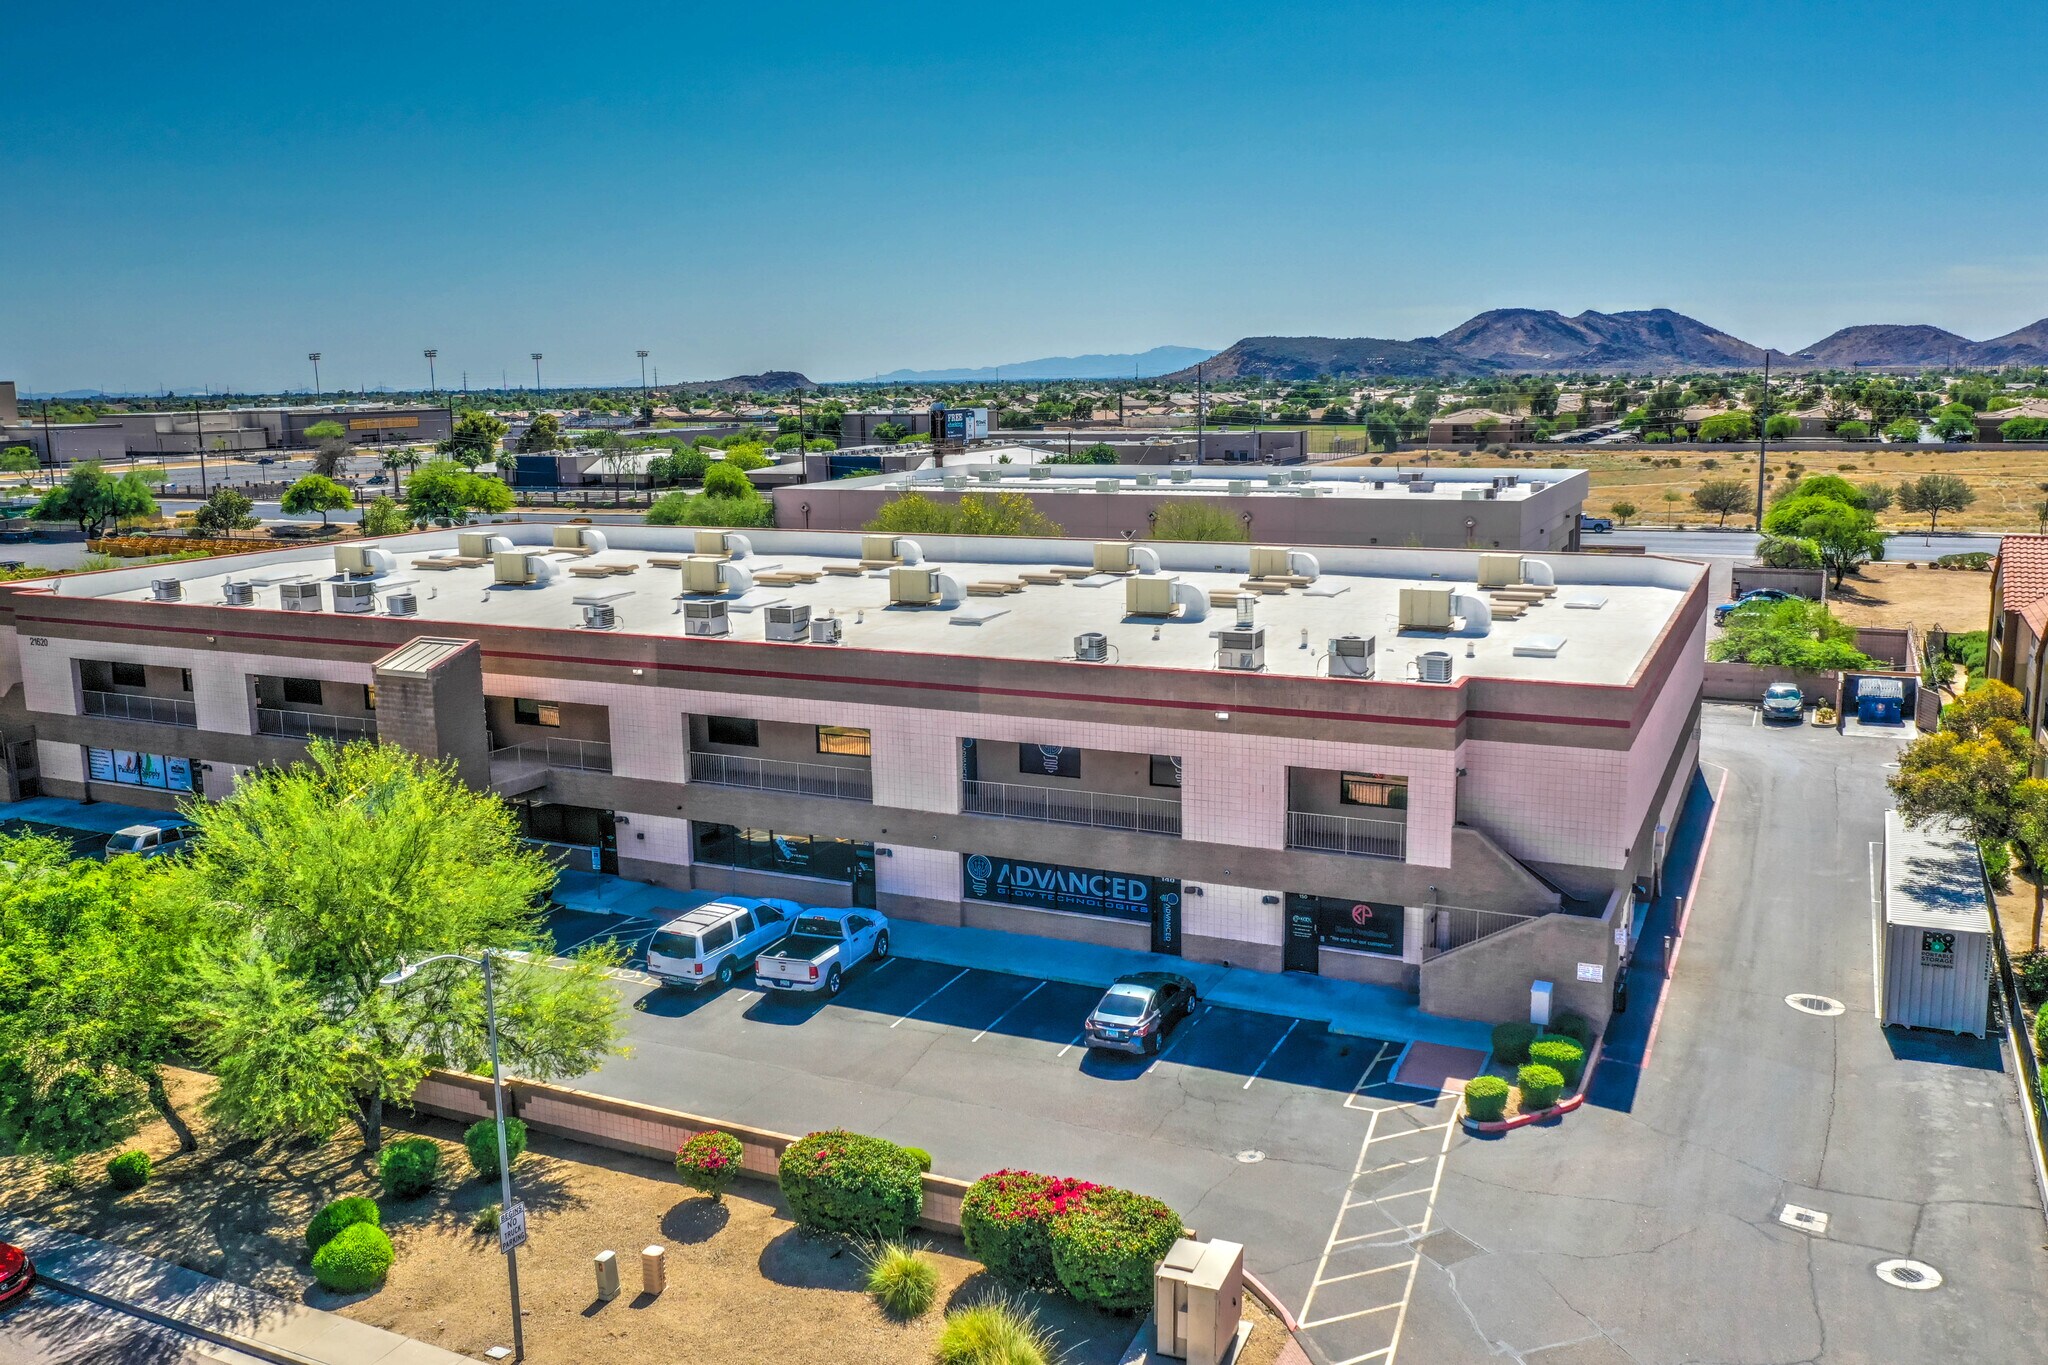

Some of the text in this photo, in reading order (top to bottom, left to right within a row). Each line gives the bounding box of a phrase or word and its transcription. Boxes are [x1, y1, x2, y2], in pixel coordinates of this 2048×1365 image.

[947, 413, 963, 422] FREE
[30, 637, 48, 646] 21620
[997, 864, 1147, 901] ADVANCED
[997, 888, 1149, 913] GLOW TECHNOLOGIES
[1920, 956, 1954, 964] STORAGE
[500, 1205, 523, 1222] BEGINS
[507, 1217, 517, 1229] NO
[504, 1225, 521, 1240] TRUCK
[502, 1231, 525, 1250] PARKING
